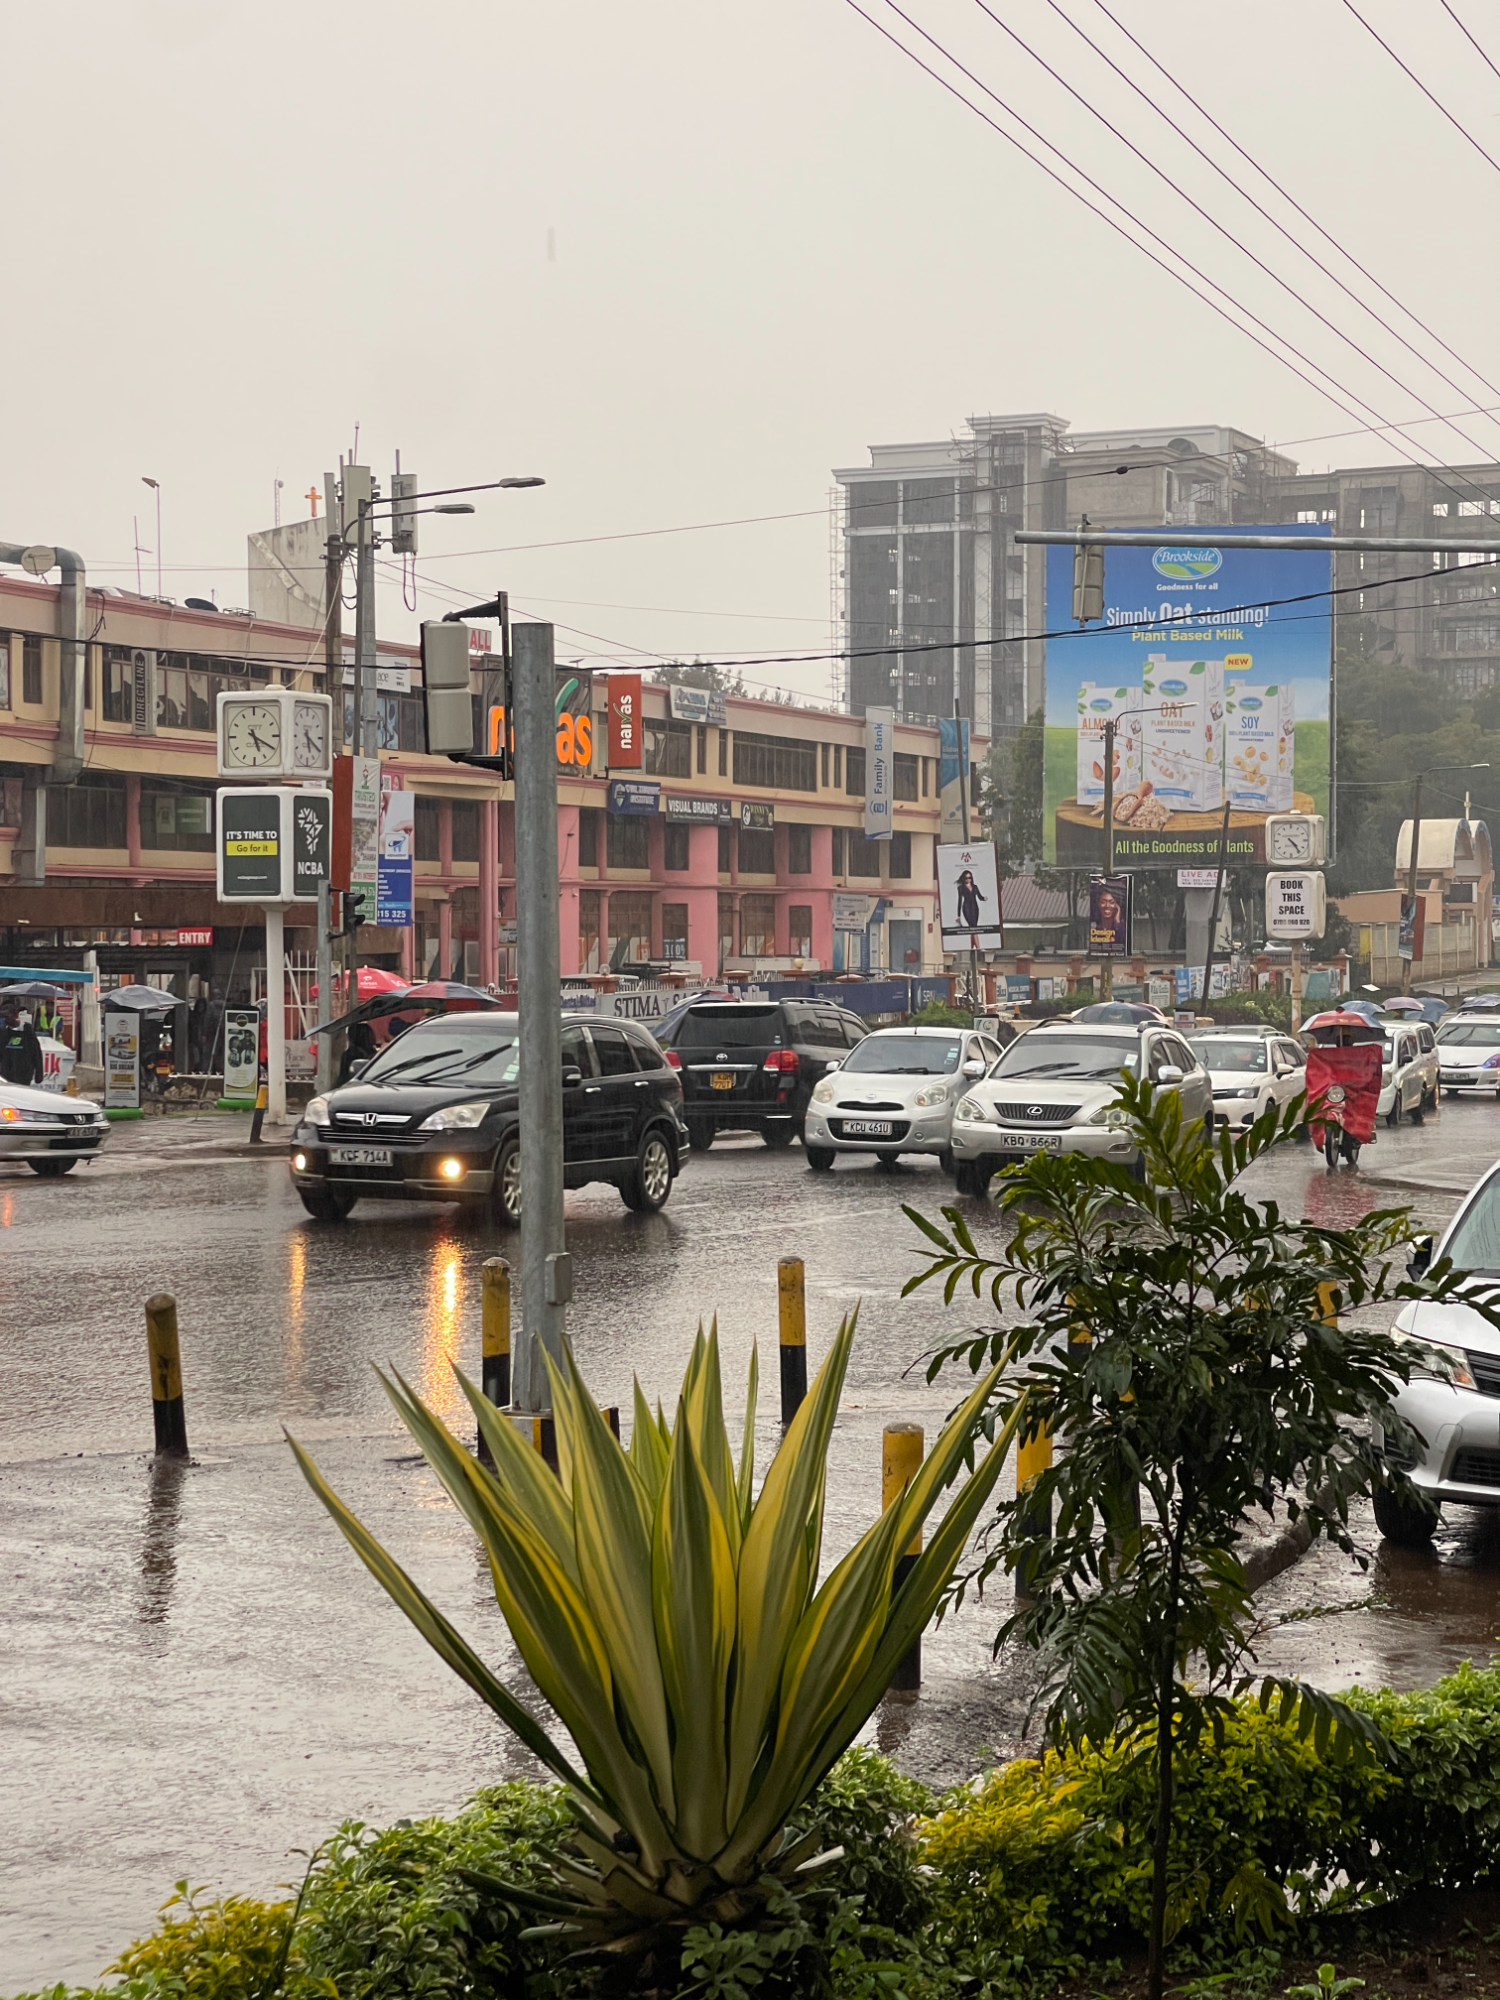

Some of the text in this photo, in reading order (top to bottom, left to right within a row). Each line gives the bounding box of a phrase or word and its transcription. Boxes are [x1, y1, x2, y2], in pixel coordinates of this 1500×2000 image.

[1160, 549, 1215, 564] Brookside
[1156, 583, 1218, 591] Goodness for all
[1106, 607, 1157, 629] Simply
[1132, 629, 1244, 642] Plant Based Milk
[1227, 658, 1249, 666] NEW
[136, 660, 145, 721] DIRECTLINE
[1160, 701, 1184, 718] OAT
[612, 694, 633, 750] naivas
[1151, 720, 1166, 728] PLANT
[1167, 720, 1183, 728] BASED
[1241, 716, 1260, 729] SOY
[874, 722, 885, 795] Family Bank
[668, 800, 718, 815] VISUAL BRANDS
[226, 830, 278, 840] IT'S TIME TO
[236, 844, 269, 853] Go for it
[1115, 839, 1254, 854] All the Goodness of lants
[297, 861, 324, 875] NCBA
[1280, 880, 1304, 890] BOOK
[1282, 892, 1302, 902] THIS
[391, 910, 407, 918] 325
[1278, 905, 1305, 915] SPACE
[178, 932, 211, 944] ENTRY
[1090, 928, 1116, 937] Design
[614, 995, 663, 1018] STIMA
[850, 1121, 889, 1134] KCU 461U
